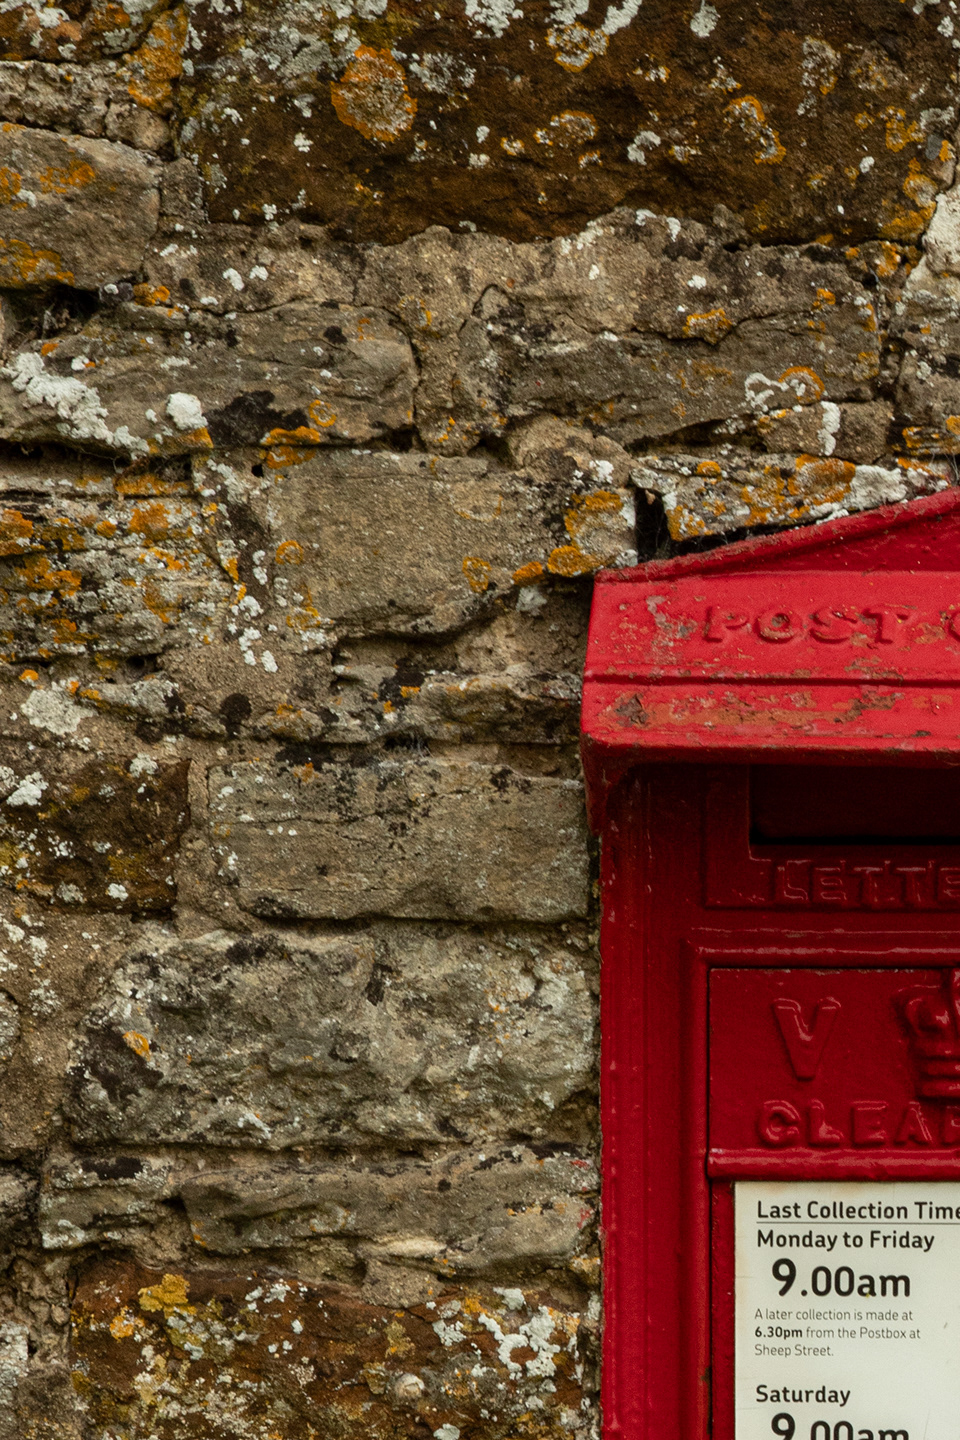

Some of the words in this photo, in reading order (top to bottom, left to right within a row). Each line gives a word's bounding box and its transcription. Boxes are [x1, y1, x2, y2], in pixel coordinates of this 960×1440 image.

[702, 606, 910, 645] POST
[771, 998, 841, 1080] V
[757, 1200, 801, 1219] Last
[806, 1200, 908, 1220] Collection
[757, 1229, 838, 1252] Monday
[843, 1231, 864, 1249] to
[870, 1230, 935, 1252] Friday
[771, 1257, 911, 1297] 9.00am
[754, 1308, 763, 1320] A
[765, 1308, 794, 1321] later
[796, 1308, 851, 1321] collection
[853, 1309, 863, 1321] is
[866, 1309, 899, 1321] made
[901, 1310, 914, 1321] at
[754, 1326, 803, 1340] 6.30pm
[806, 1326, 835, 1339] from
[837, 1326, 857, 1339] the
[860, 1327, 907, 1340] Postbox
[909, 1328, 921, 1340] at
[754, 1344, 792, 1358] Sheep
[794, 1344, 834, 1357] Street.
[755, 1384, 851, 1407] Saturday
